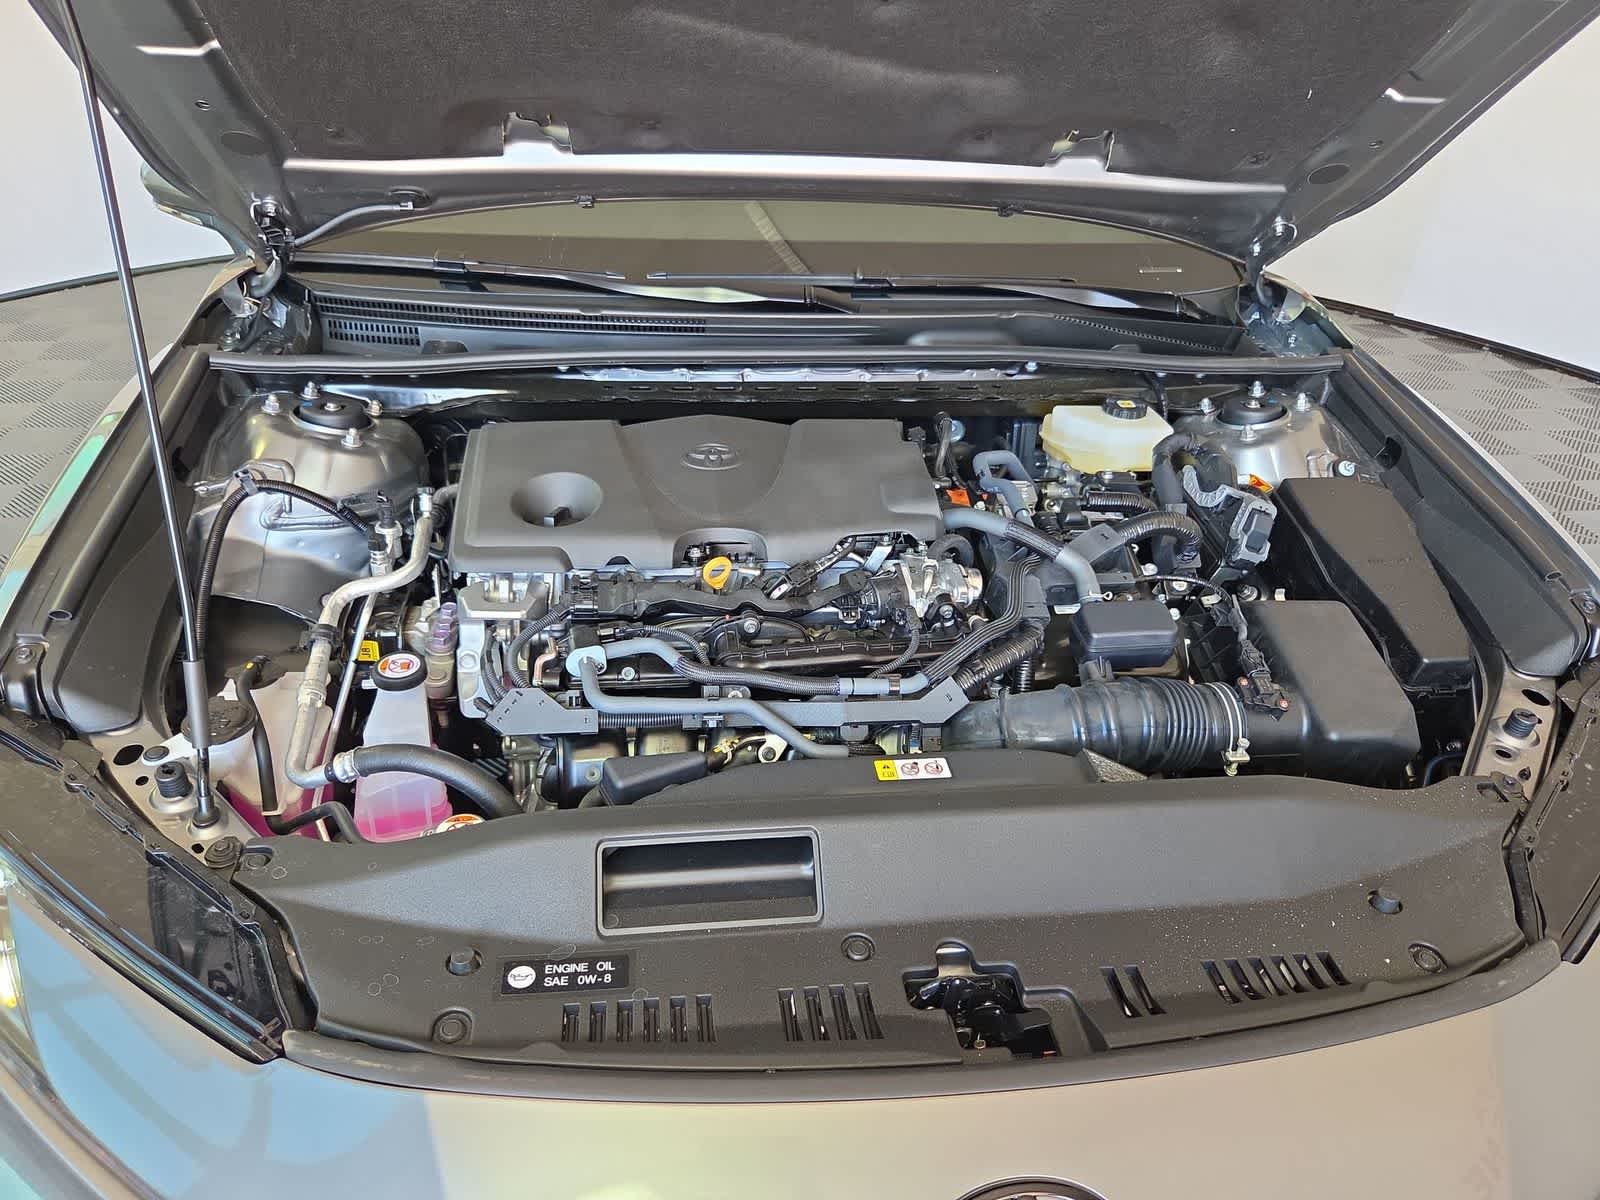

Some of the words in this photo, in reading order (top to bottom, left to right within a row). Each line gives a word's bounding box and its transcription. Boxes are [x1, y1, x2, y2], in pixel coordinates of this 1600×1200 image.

[544, 962, 589, 974] ENGINE
[596, 961, 616, 971] OIL
[543, 976, 569, 987] SAE
[577, 973, 612, 985] 0W-8
